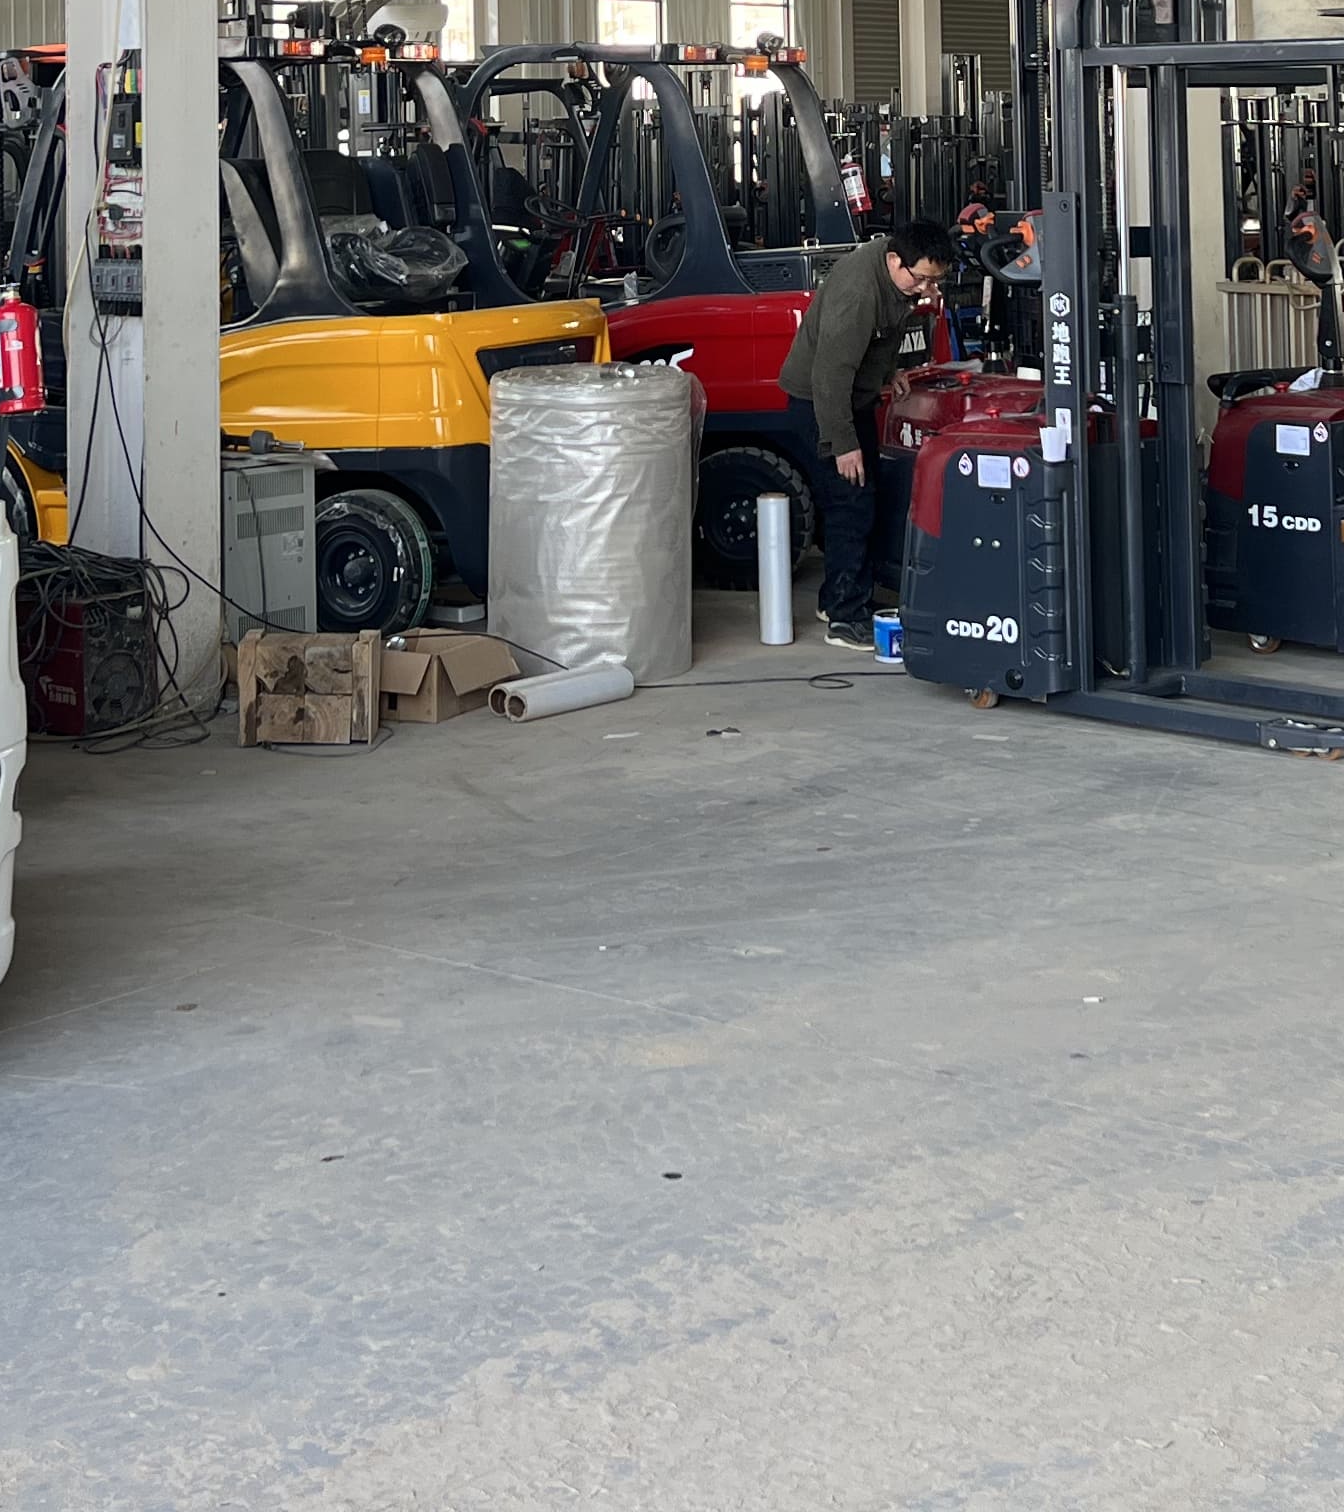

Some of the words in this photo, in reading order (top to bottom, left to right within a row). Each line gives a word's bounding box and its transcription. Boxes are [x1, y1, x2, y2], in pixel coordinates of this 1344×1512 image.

[1051, 322, 1072, 385] 地跑王
[1248, 504, 1278, 528] 15
[1282, 516, 1321, 532] CDD
[946, 619, 984, 639] CDD
[986, 615, 1018, 644] 20
